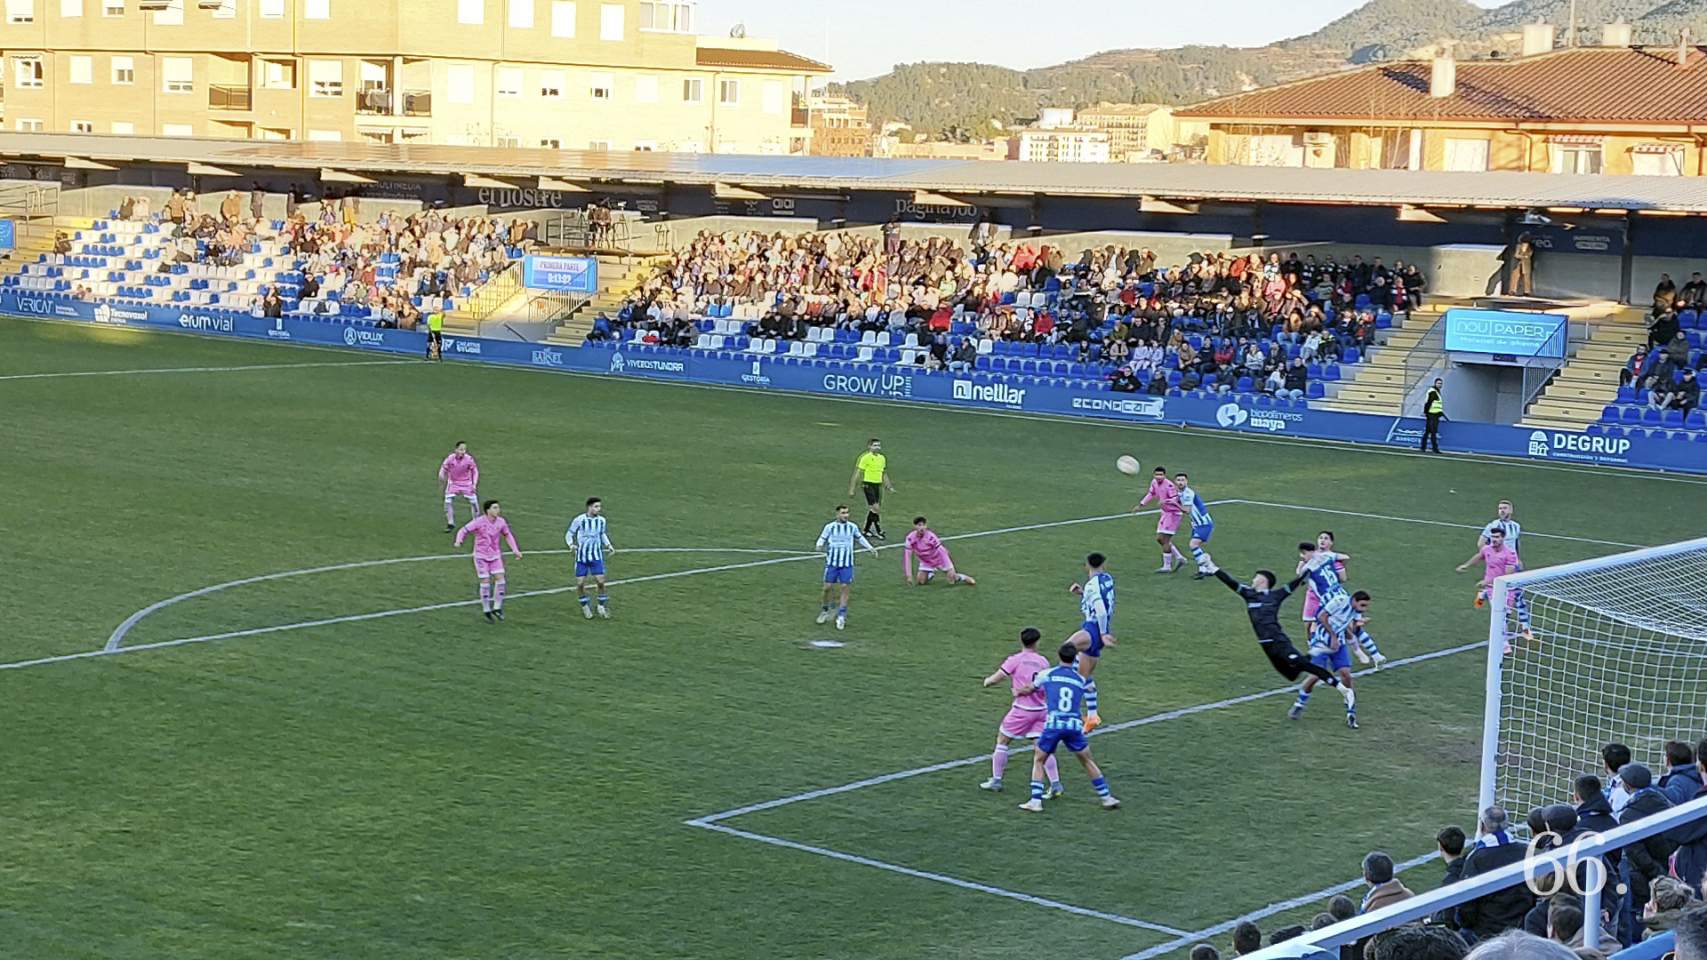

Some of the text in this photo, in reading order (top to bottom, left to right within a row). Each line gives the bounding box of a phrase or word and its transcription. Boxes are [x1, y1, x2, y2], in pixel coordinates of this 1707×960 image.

[16, 296, 54, 314] VERICAT
[1494, 323, 1543, 337] PAPER
[823, 374, 904, 394] GROW UP
[1250, 417, 1285, 431] maya
[1553, 433, 1631, 454] DEGRUP
[1320, 565, 1338, 587] 15
[1058, 686, 1073, 713] 8
